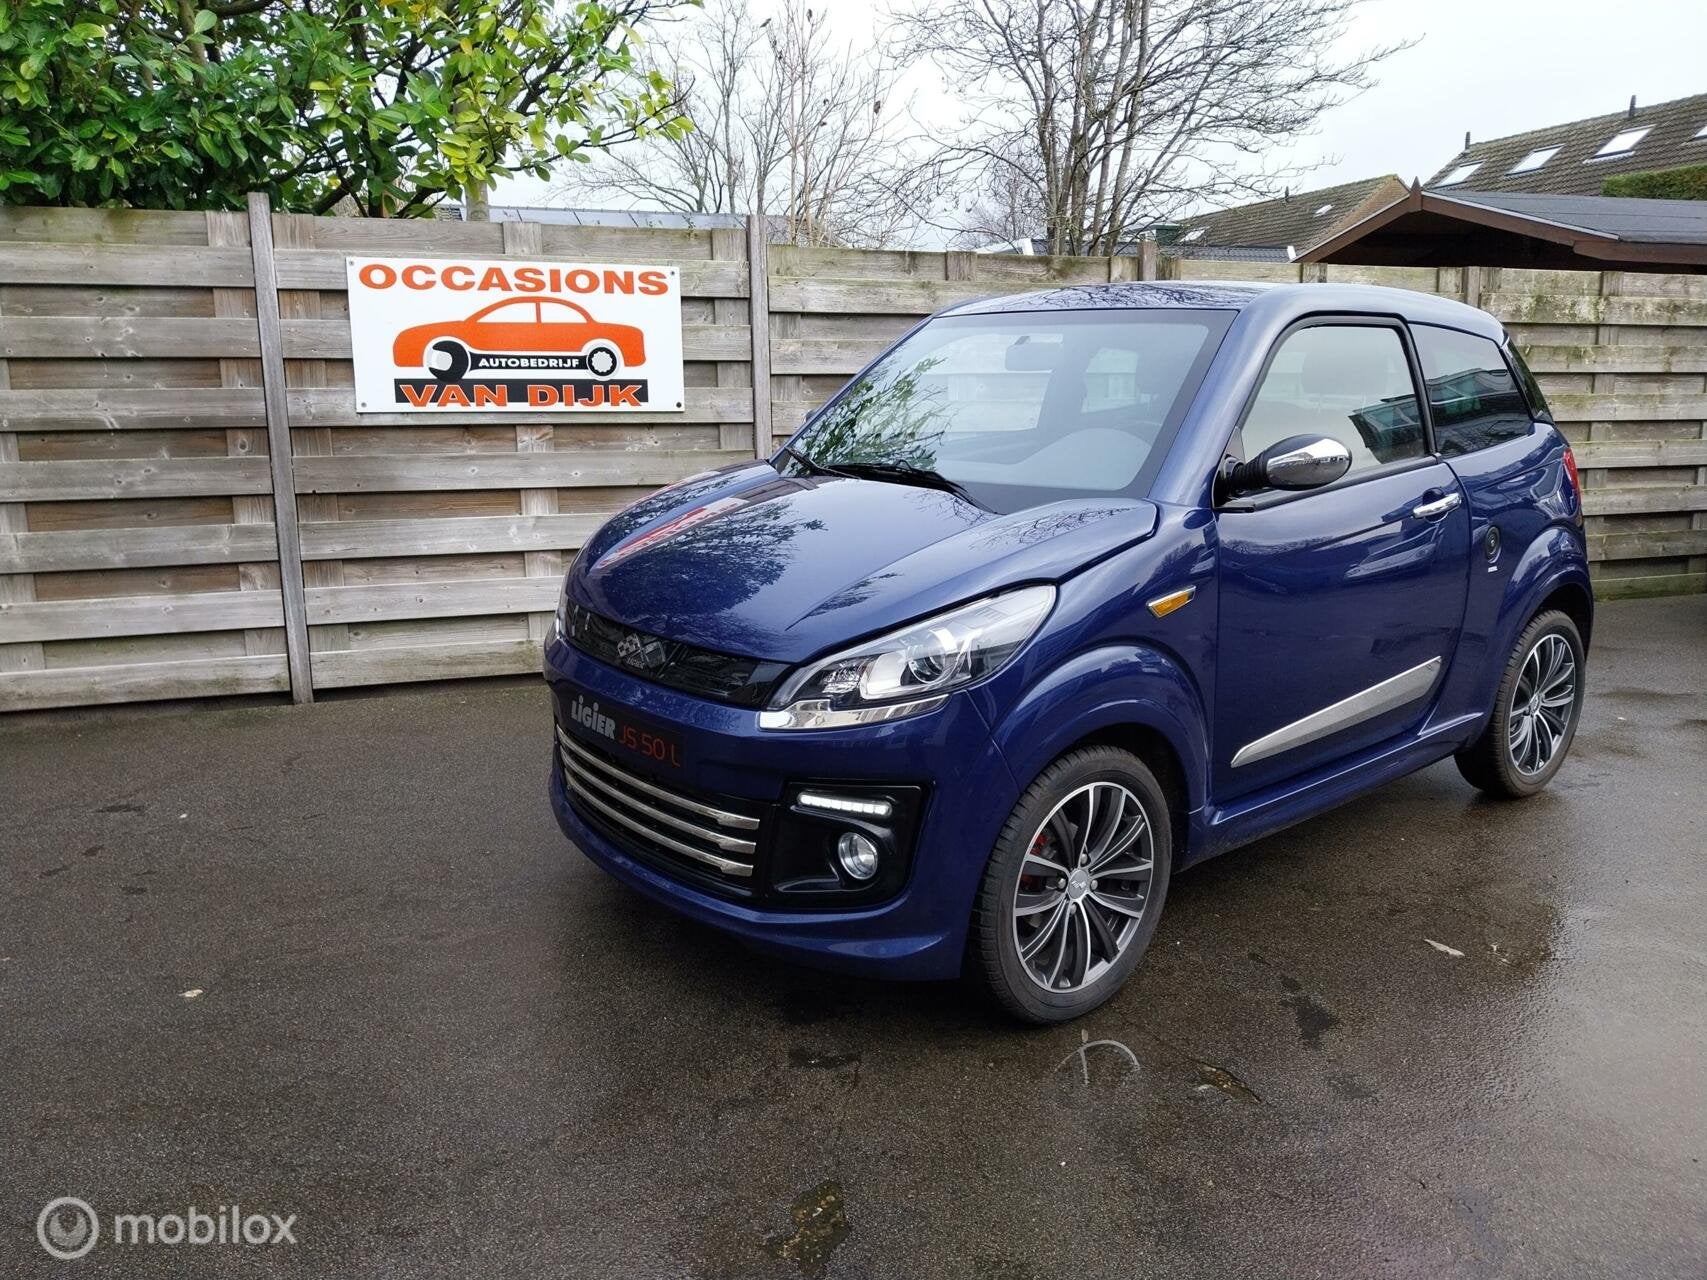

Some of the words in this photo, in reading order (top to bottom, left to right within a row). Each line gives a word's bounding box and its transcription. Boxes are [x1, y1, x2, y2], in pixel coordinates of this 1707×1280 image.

[358, 263, 669, 295] OCCASIONS
[478, 357, 580, 368] AUTOBEDRIJF
[399, 384, 508, 407] VAN
[526, 384, 642, 407] DIJK
[619, 725, 637, 749] JS
[641, 734, 665, 760] 50
[671, 743, 681, 768] L
